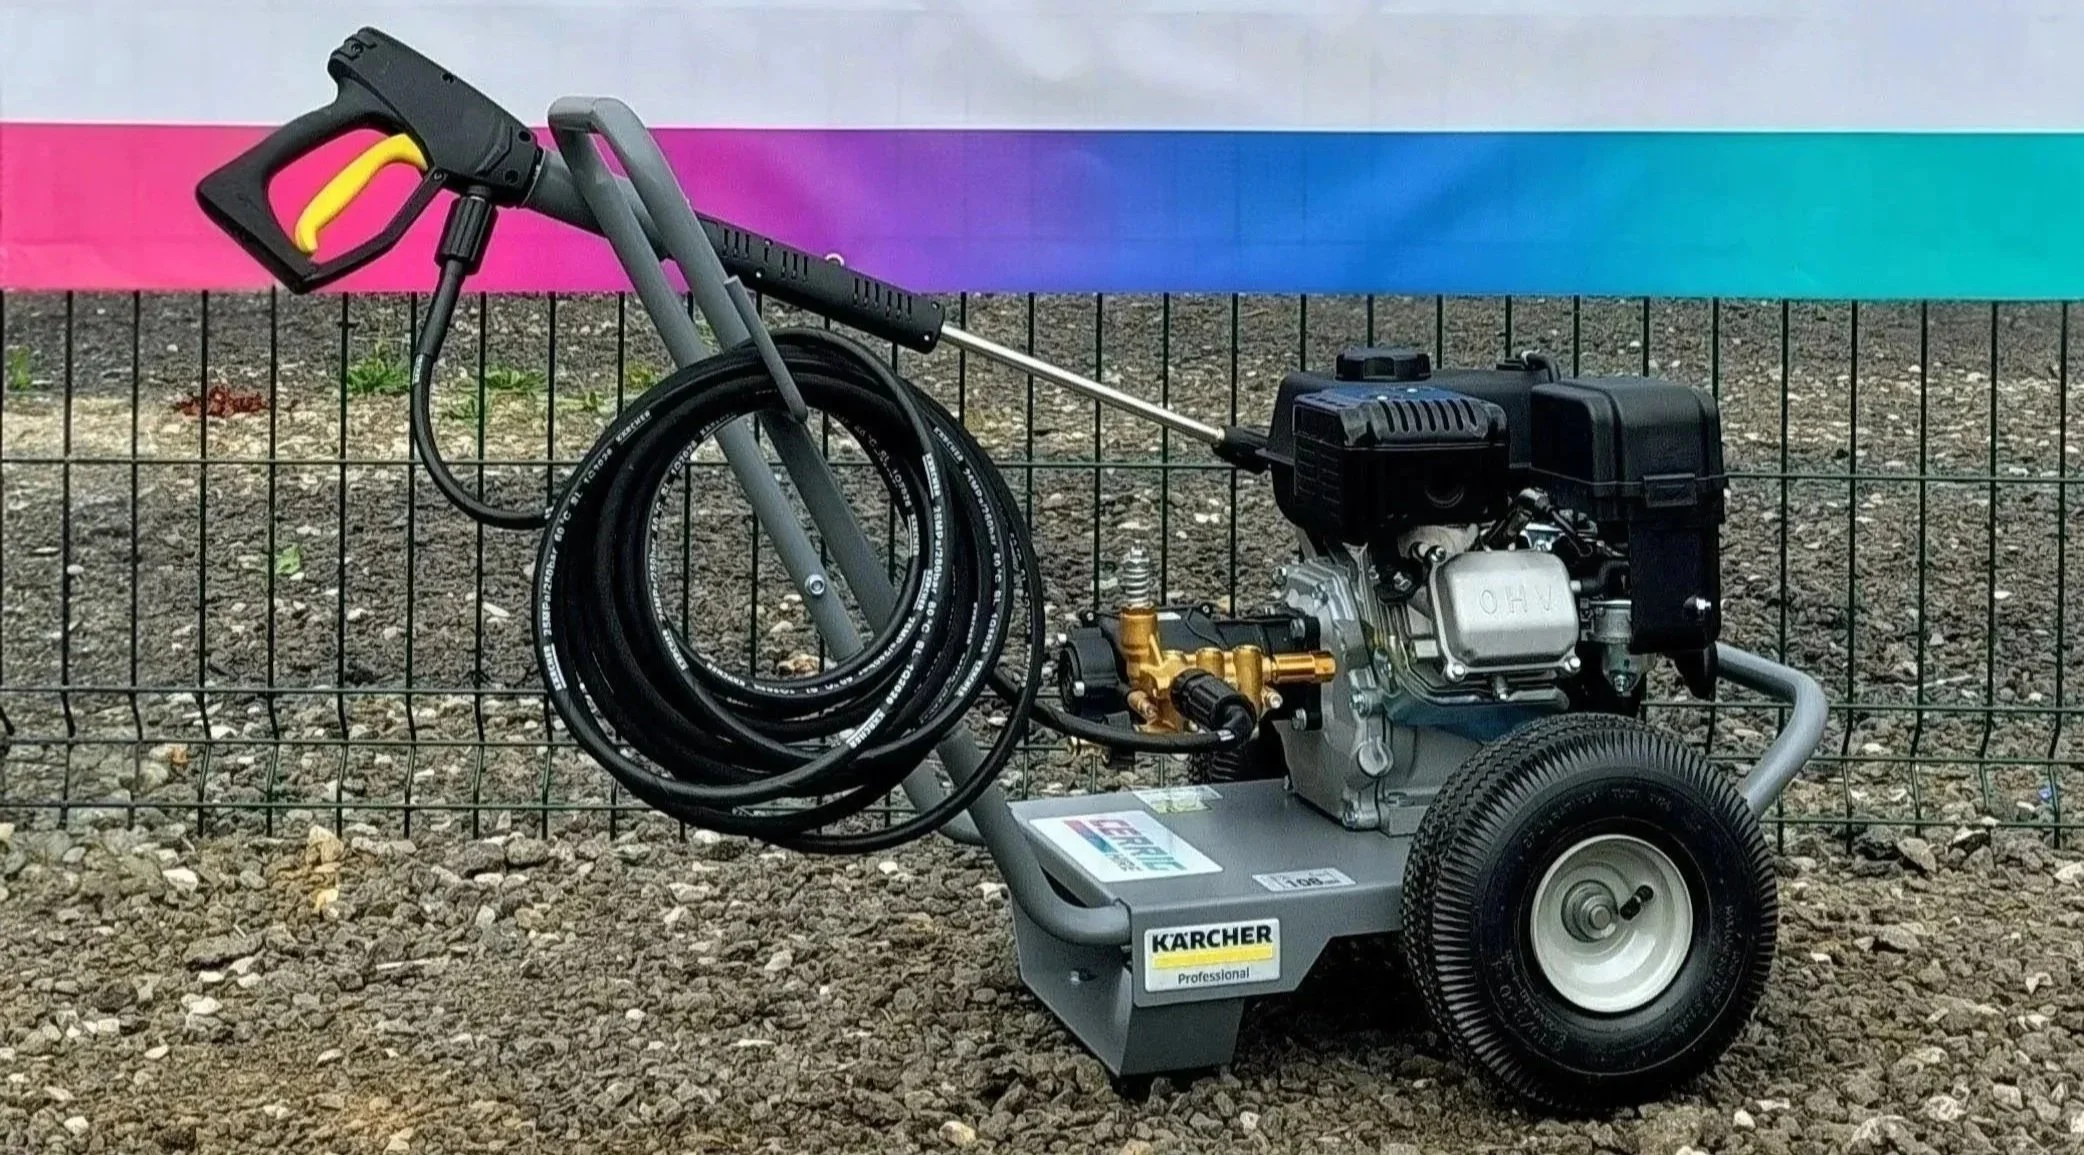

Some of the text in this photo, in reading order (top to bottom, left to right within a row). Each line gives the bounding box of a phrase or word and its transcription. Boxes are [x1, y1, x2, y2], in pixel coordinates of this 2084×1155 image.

[1480, 584, 1551, 615] OHV
[1152, 924, 1273, 953] KÄRCHER
[1178, 967, 1250, 985] Professional
